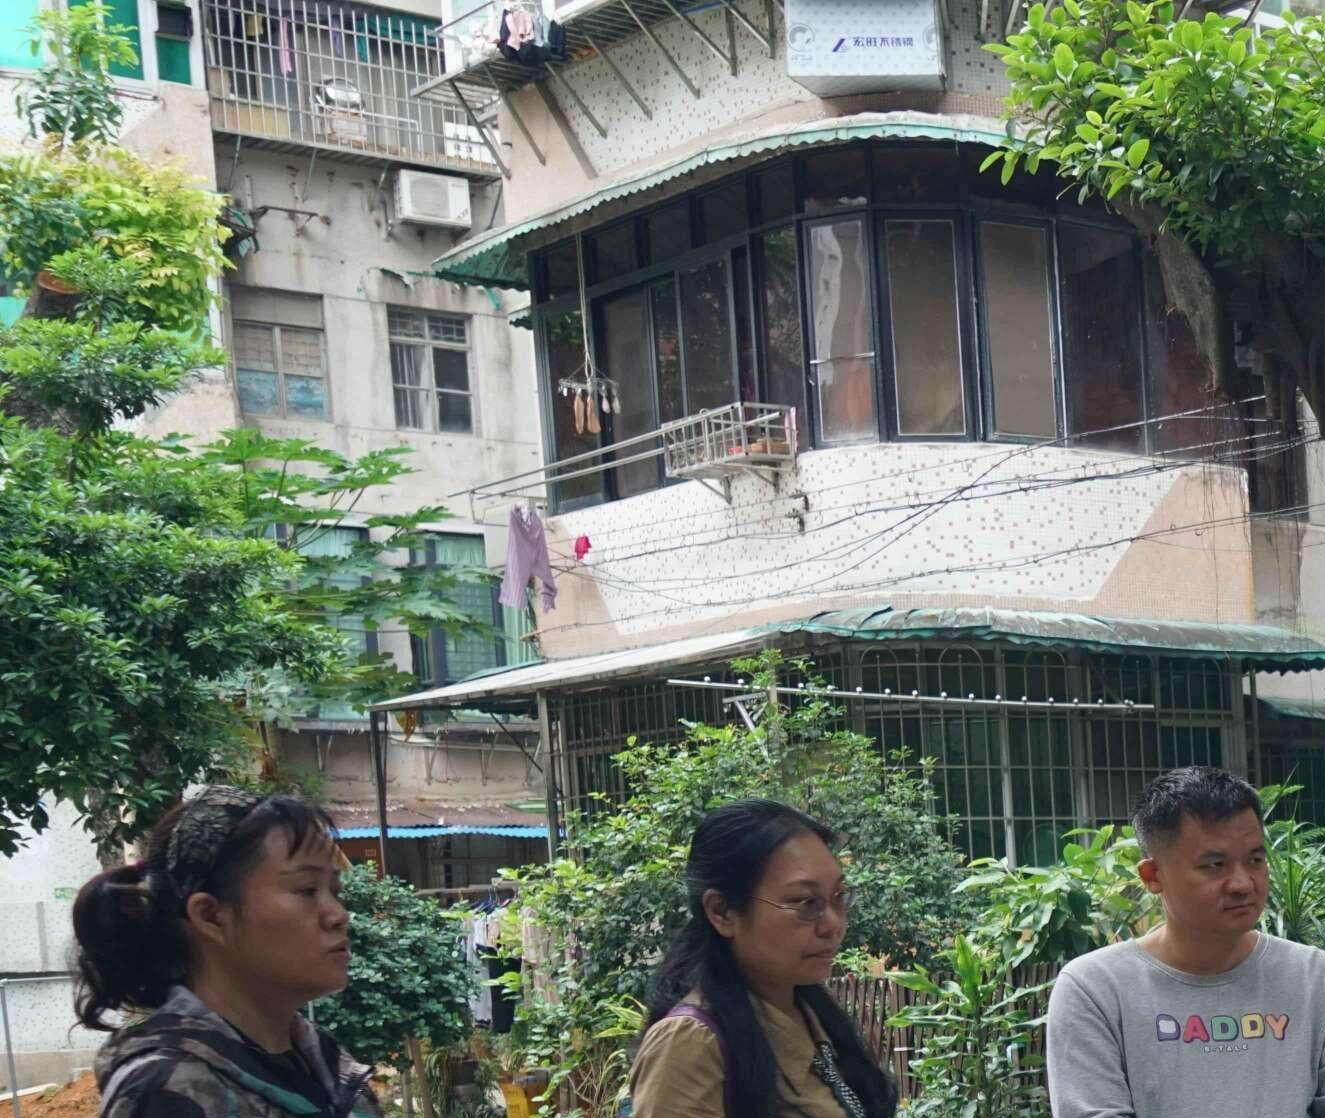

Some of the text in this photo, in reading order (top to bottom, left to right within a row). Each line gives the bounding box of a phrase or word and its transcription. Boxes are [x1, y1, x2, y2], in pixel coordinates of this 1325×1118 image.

[852, 36, 914, 48] 宏旺不锈钢
[1155, 1013, 1290, 1043] DADDY
